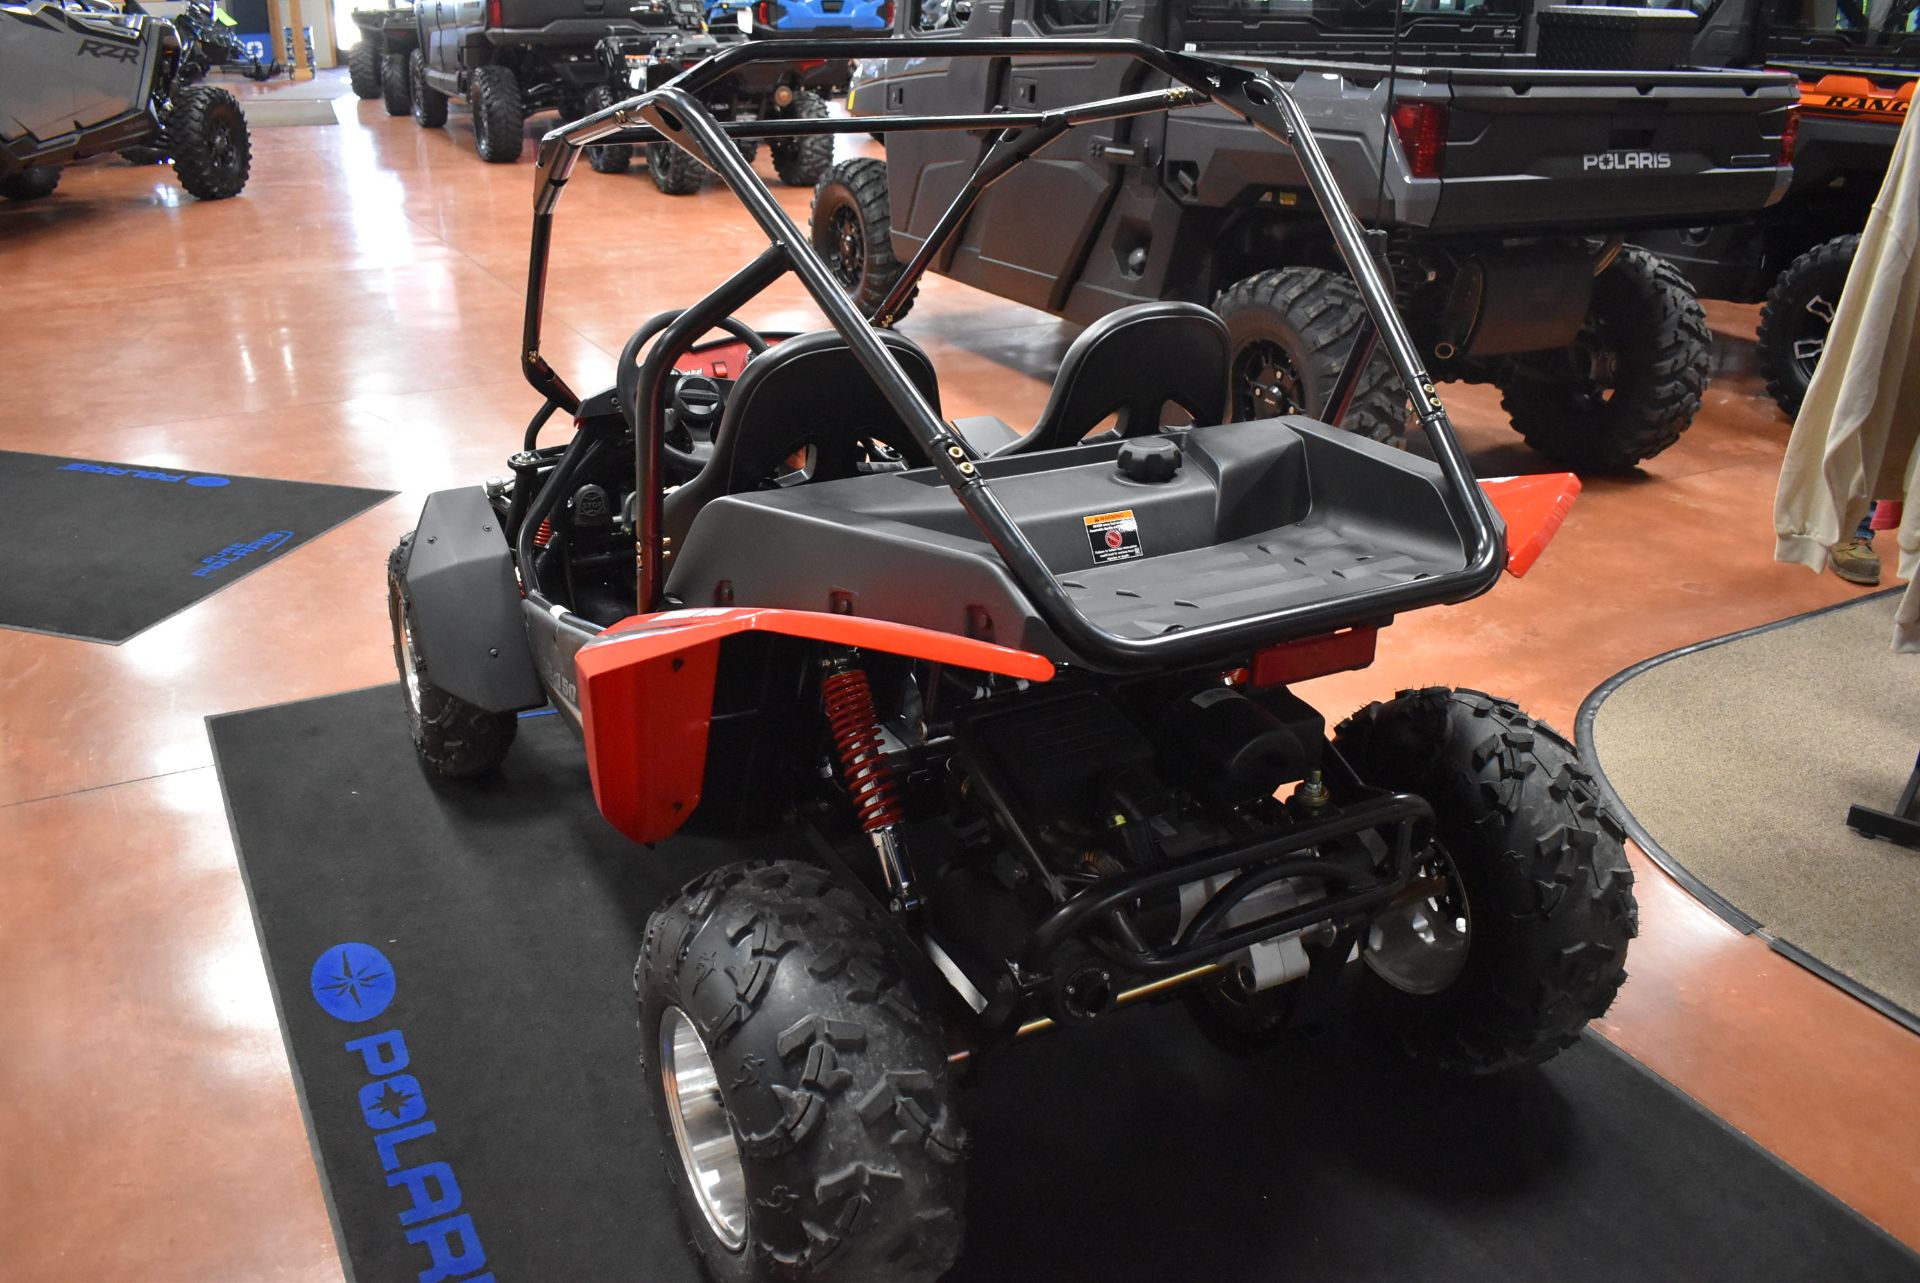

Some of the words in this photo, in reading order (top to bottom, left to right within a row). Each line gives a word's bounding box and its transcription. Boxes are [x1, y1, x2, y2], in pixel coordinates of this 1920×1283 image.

[77, 39, 139, 65] RZR
[1583, 152, 1672, 171] POLARIS
[65, 463, 187, 482] POLARIS
[191, 531, 283, 577] POLARIS
[201, 543, 246, 564] PURE
[344, 1029, 496, 1283] POLAR
